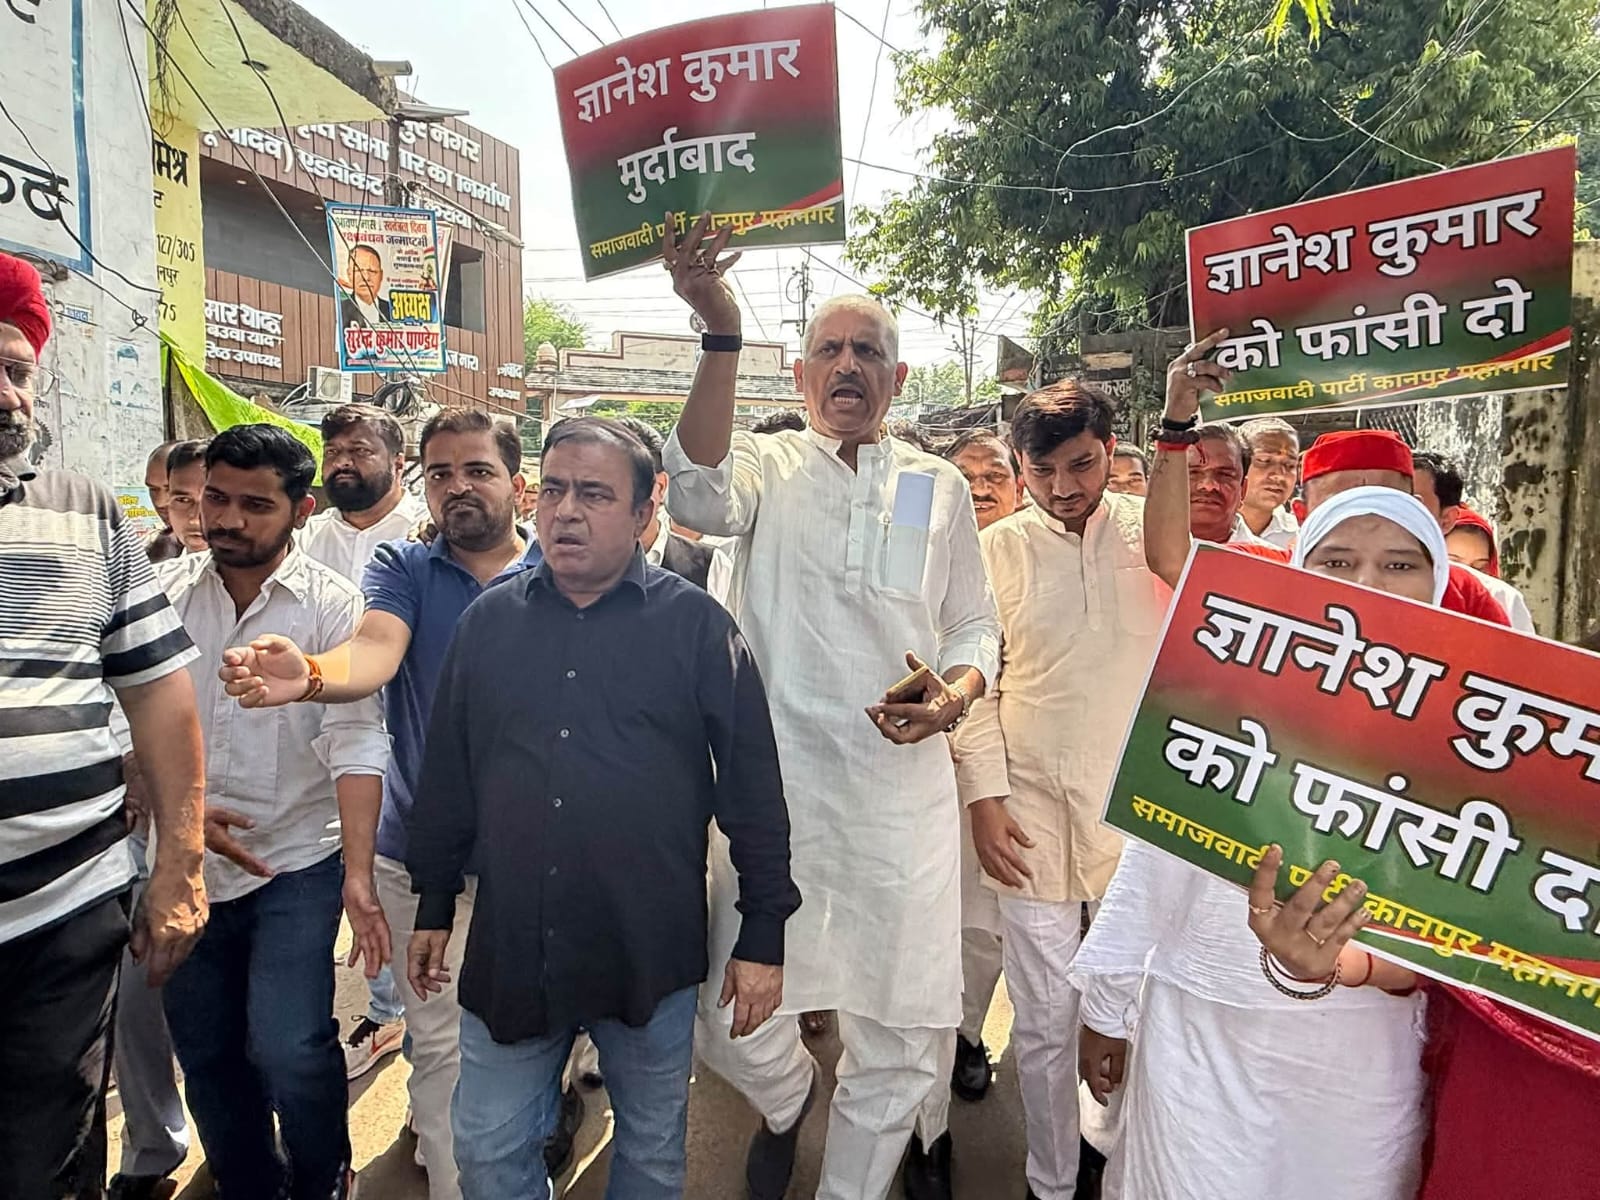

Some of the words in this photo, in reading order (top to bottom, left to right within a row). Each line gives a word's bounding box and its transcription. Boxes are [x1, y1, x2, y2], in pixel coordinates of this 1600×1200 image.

[574, 57, 671, 122] ज्ञानेश
[681, 39, 800, 102] कुमार
[617, 127, 756, 204] मुर्दाबाद
[156, 235, 195, 265] 127/305
[590, 223, 653, 259] समाजवादी
[760, 206, 835, 230] महानगर
[1204, 225, 1354, 294] ज्ञानेश
[1367, 188, 1544, 277] कुमार
[1214, 320, 1283, 373] को
[1296, 291, 1448, 361] फांसी
[1462, 277, 1534, 340] दो
[1213, 380, 1315, 407] समाजवादी
[1321, 371, 1367, 396] पार्टी
[1372, 367, 1450, 390] कानपुर
[1456, 354, 1555, 379] महानगर
[1195, 592, 1447, 720] ज्ञानेश
[1452, 669, 1600, 783] कुम
[1162, 716, 1278, 805] को
[1290, 761, 1524, 896] फांसी
[1533, 849, 1600, 937] द
[1362, 892, 1482, 957] कानपुर
[1489, 941, 1600, 1009] महानग
